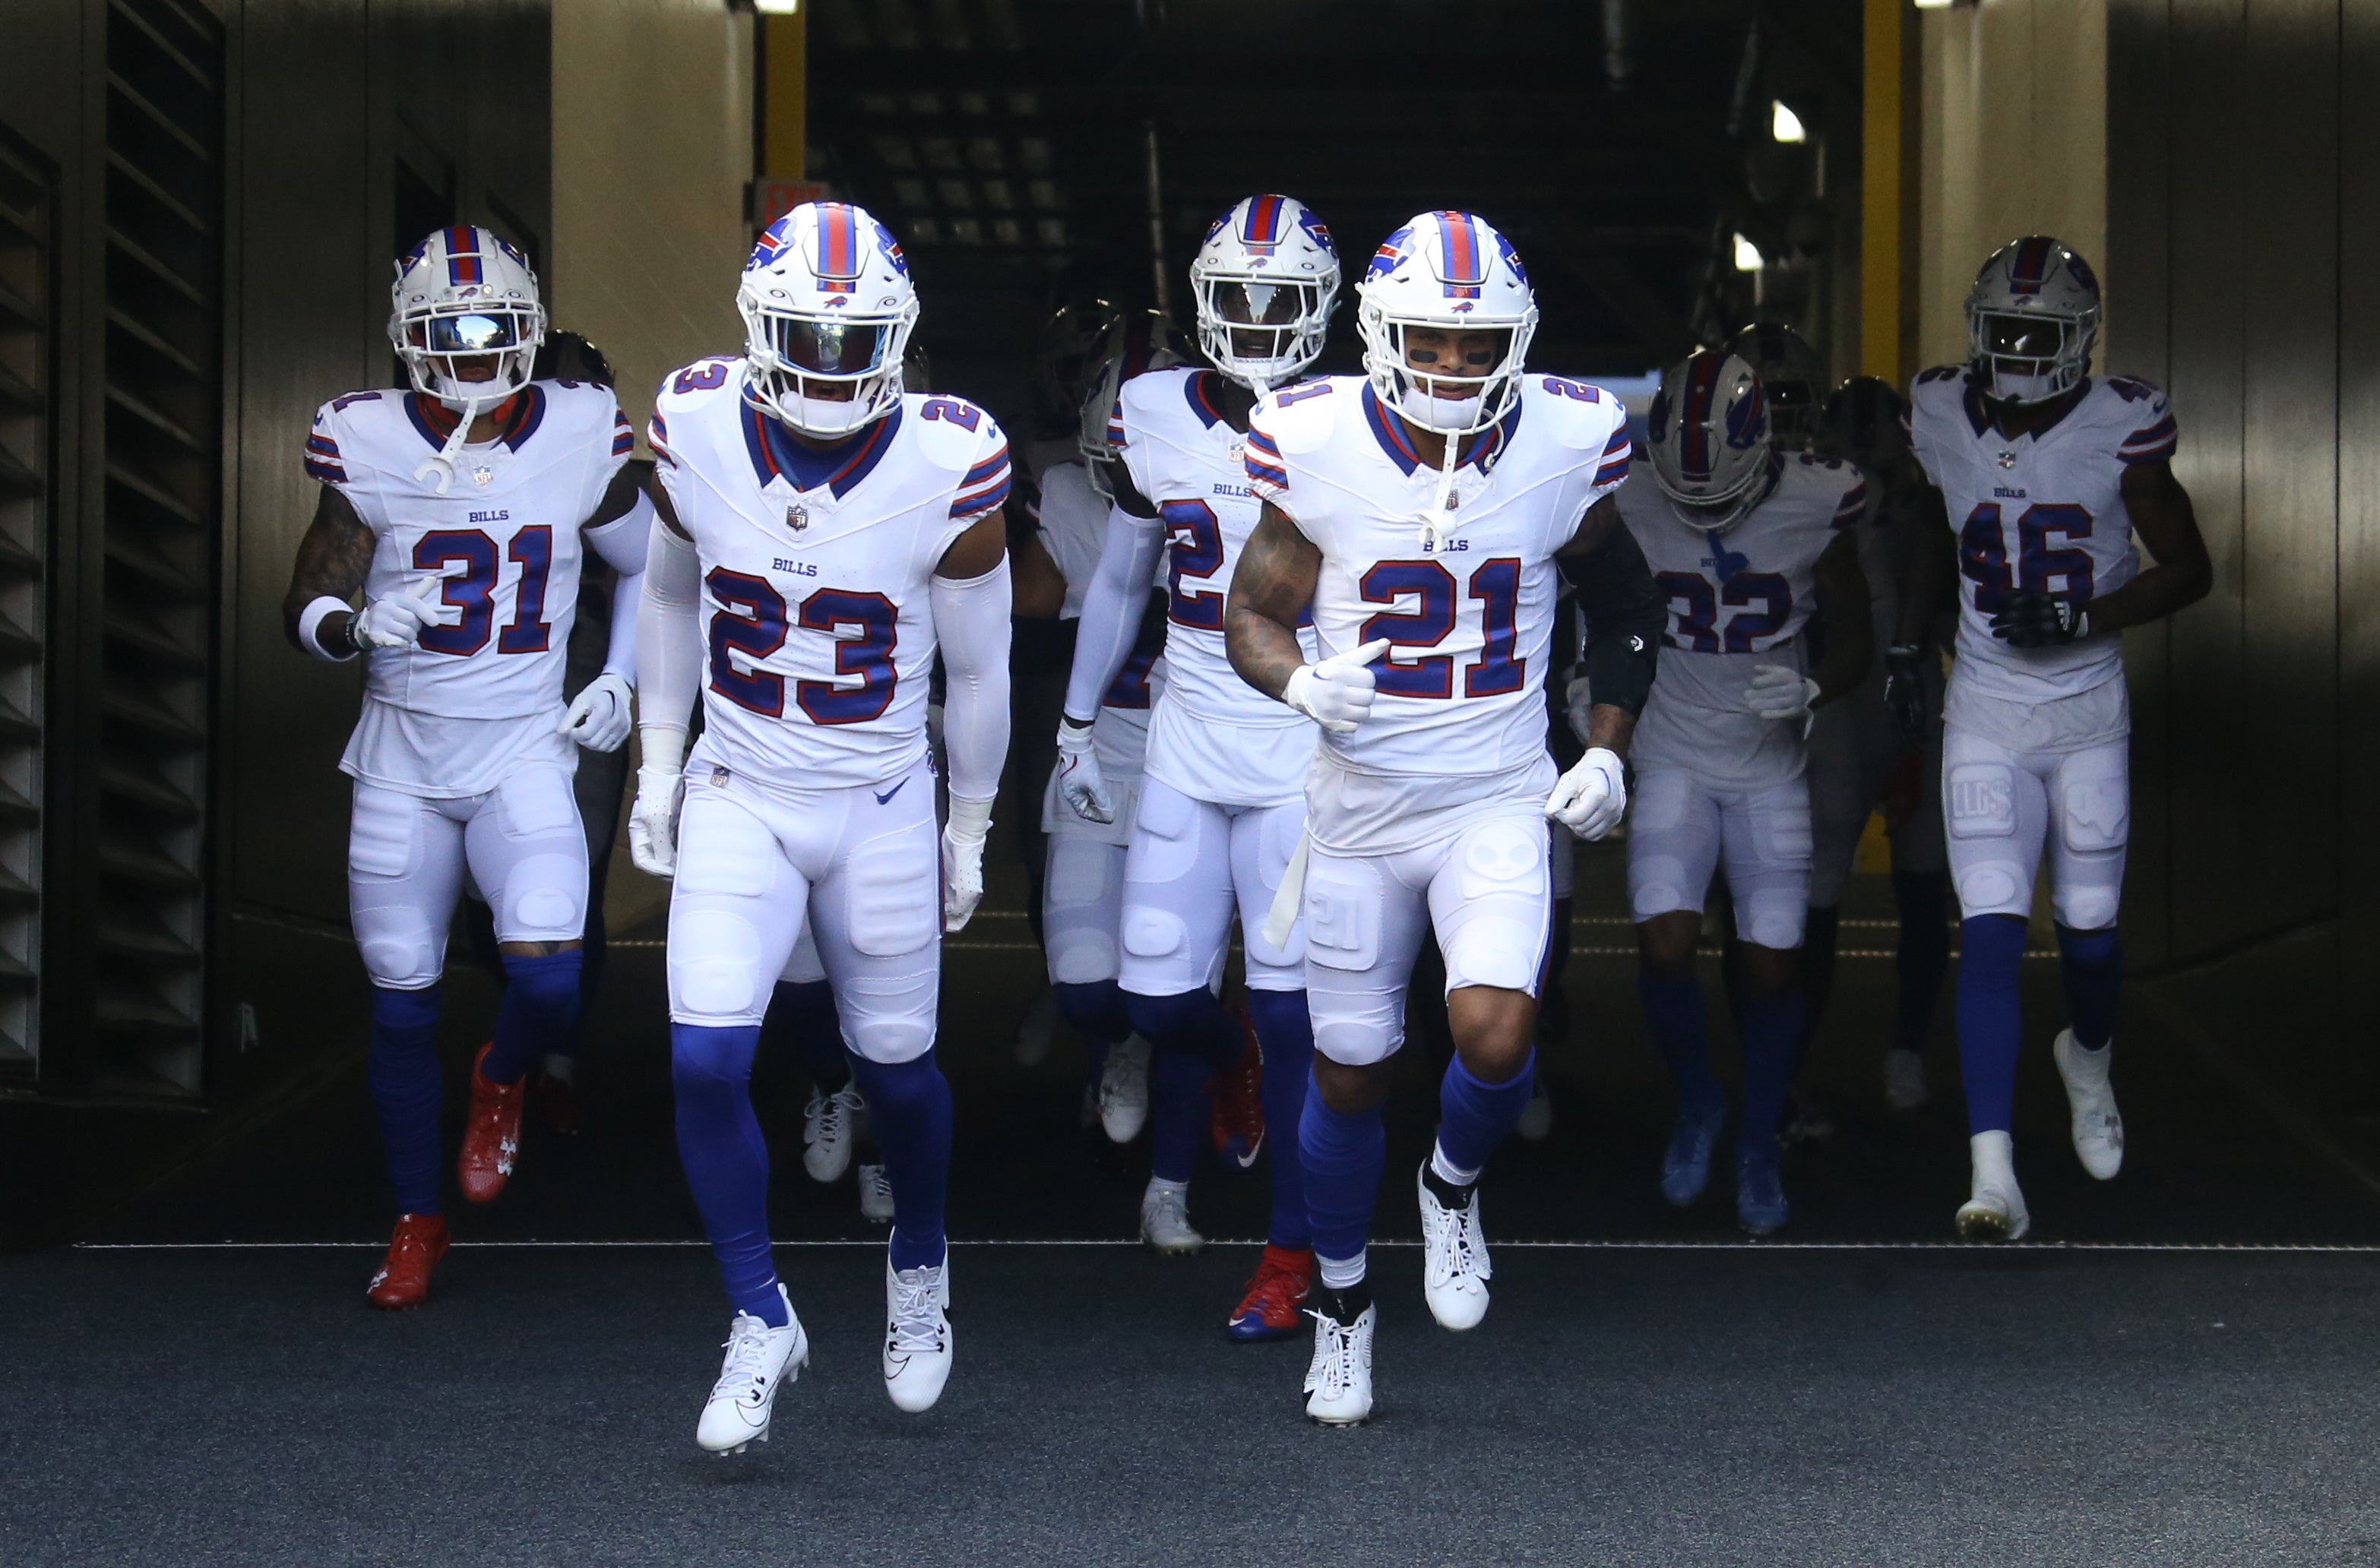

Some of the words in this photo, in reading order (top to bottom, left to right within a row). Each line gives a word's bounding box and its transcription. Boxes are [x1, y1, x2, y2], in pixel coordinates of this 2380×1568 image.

[920, 395, 980, 433] 2
[1213, 483, 1252, 498] BILLS
[1994, 488, 2027, 498] BILLS
[468, 510, 509, 523] BILLS
[1423, 539, 1469, 552] BLS
[1960, 502, 2094, 612] 46
[772, 558, 818, 577] BILLS
[413, 524, 552, 656] 31
[1360, 558, 1527, 698] 21
[705, 565, 899, 726] 23
